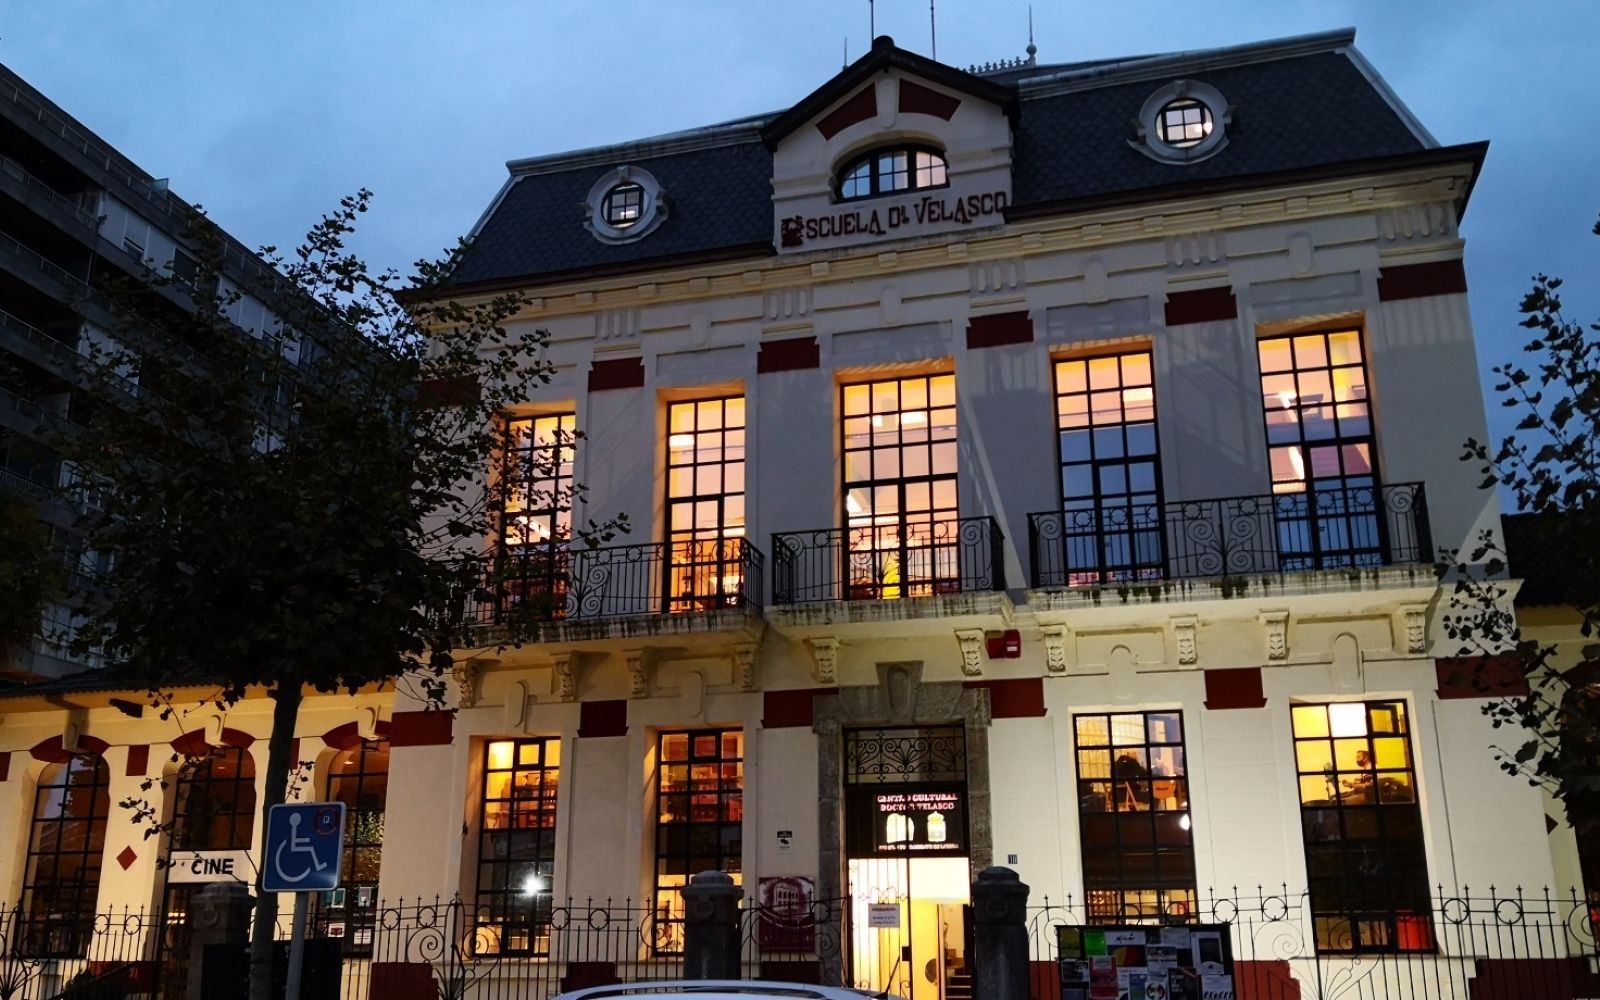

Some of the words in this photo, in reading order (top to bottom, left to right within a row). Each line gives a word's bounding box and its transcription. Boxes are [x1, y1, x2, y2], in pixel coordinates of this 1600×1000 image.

[913, 191, 1006, 224] VELASCO
[912, 793, 958, 802] CULTURAL
[916, 802, 955, 810] VELASCO
[191, 858, 234, 875] CINE
